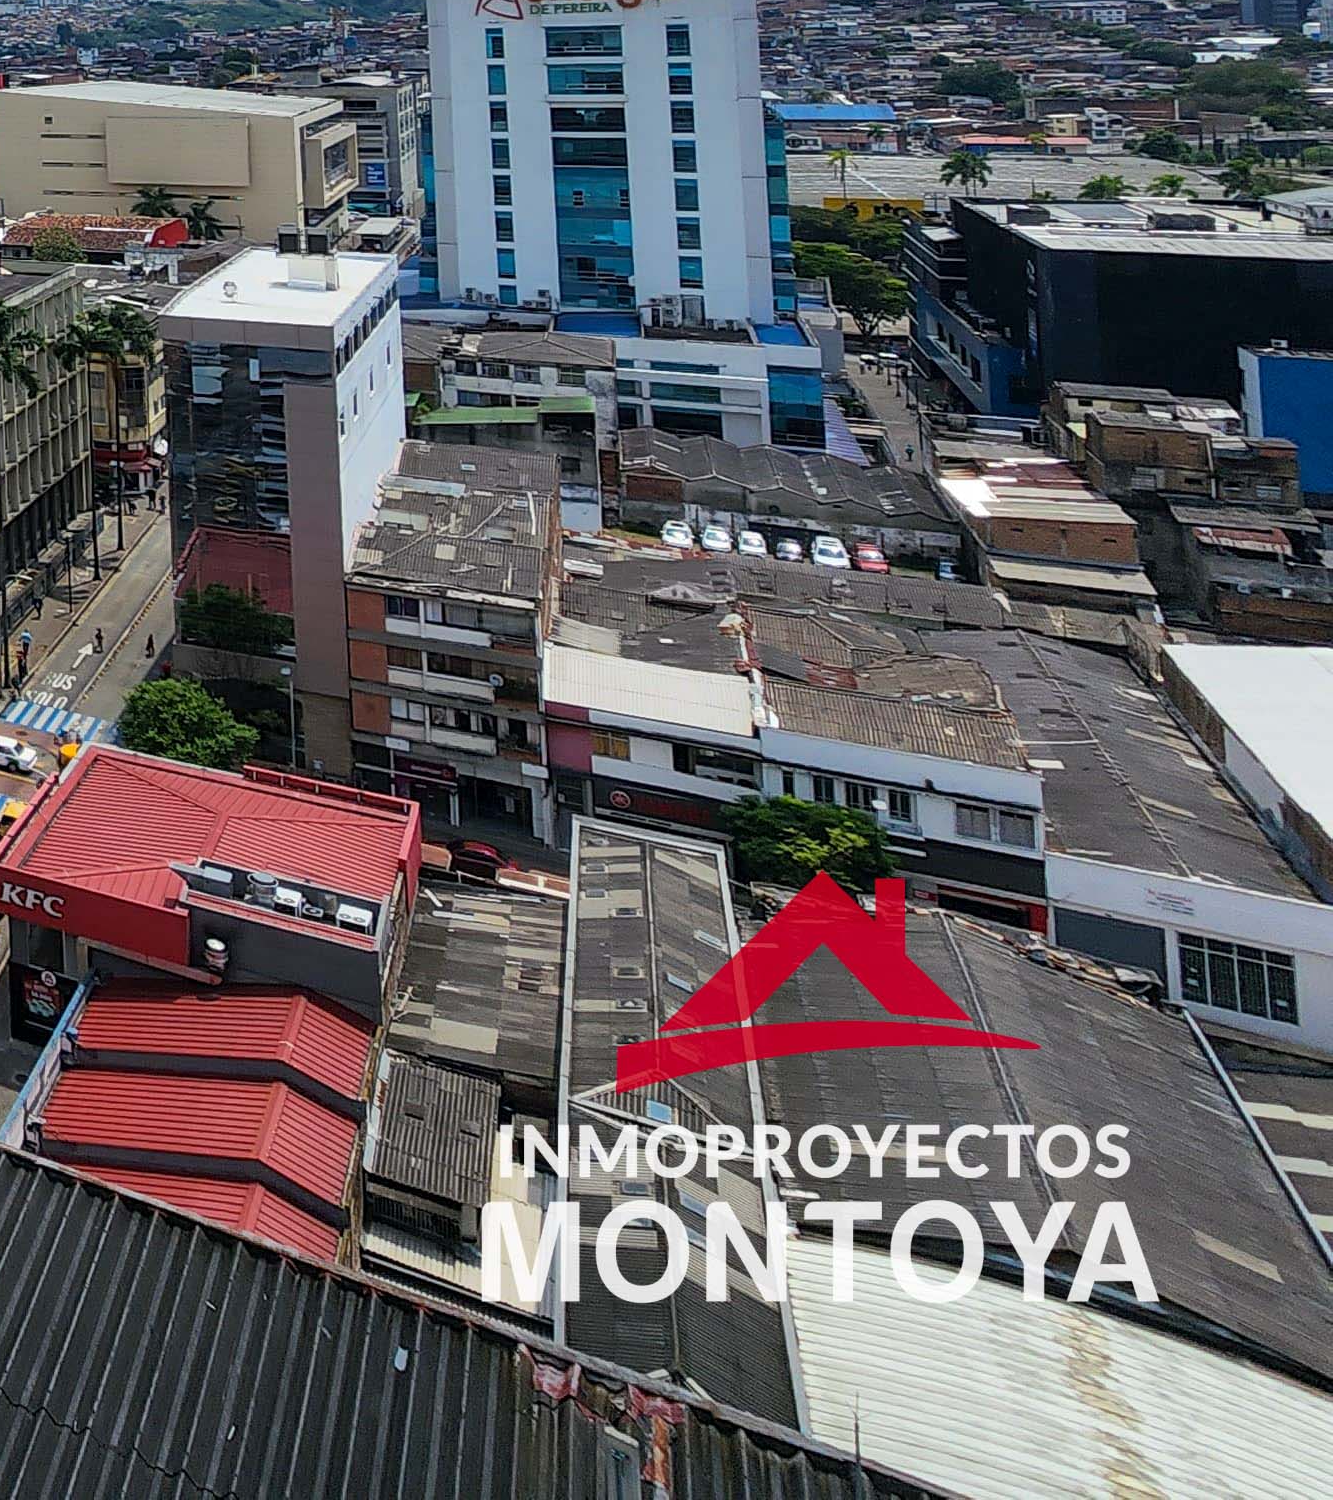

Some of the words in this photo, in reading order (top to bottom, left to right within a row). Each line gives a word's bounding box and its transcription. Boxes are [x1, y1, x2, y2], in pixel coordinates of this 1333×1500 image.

[530, 3, 550, 15] DE
[553, 1, 613, 14] PEREIRA
[0, 882, 65, 919] KFC
